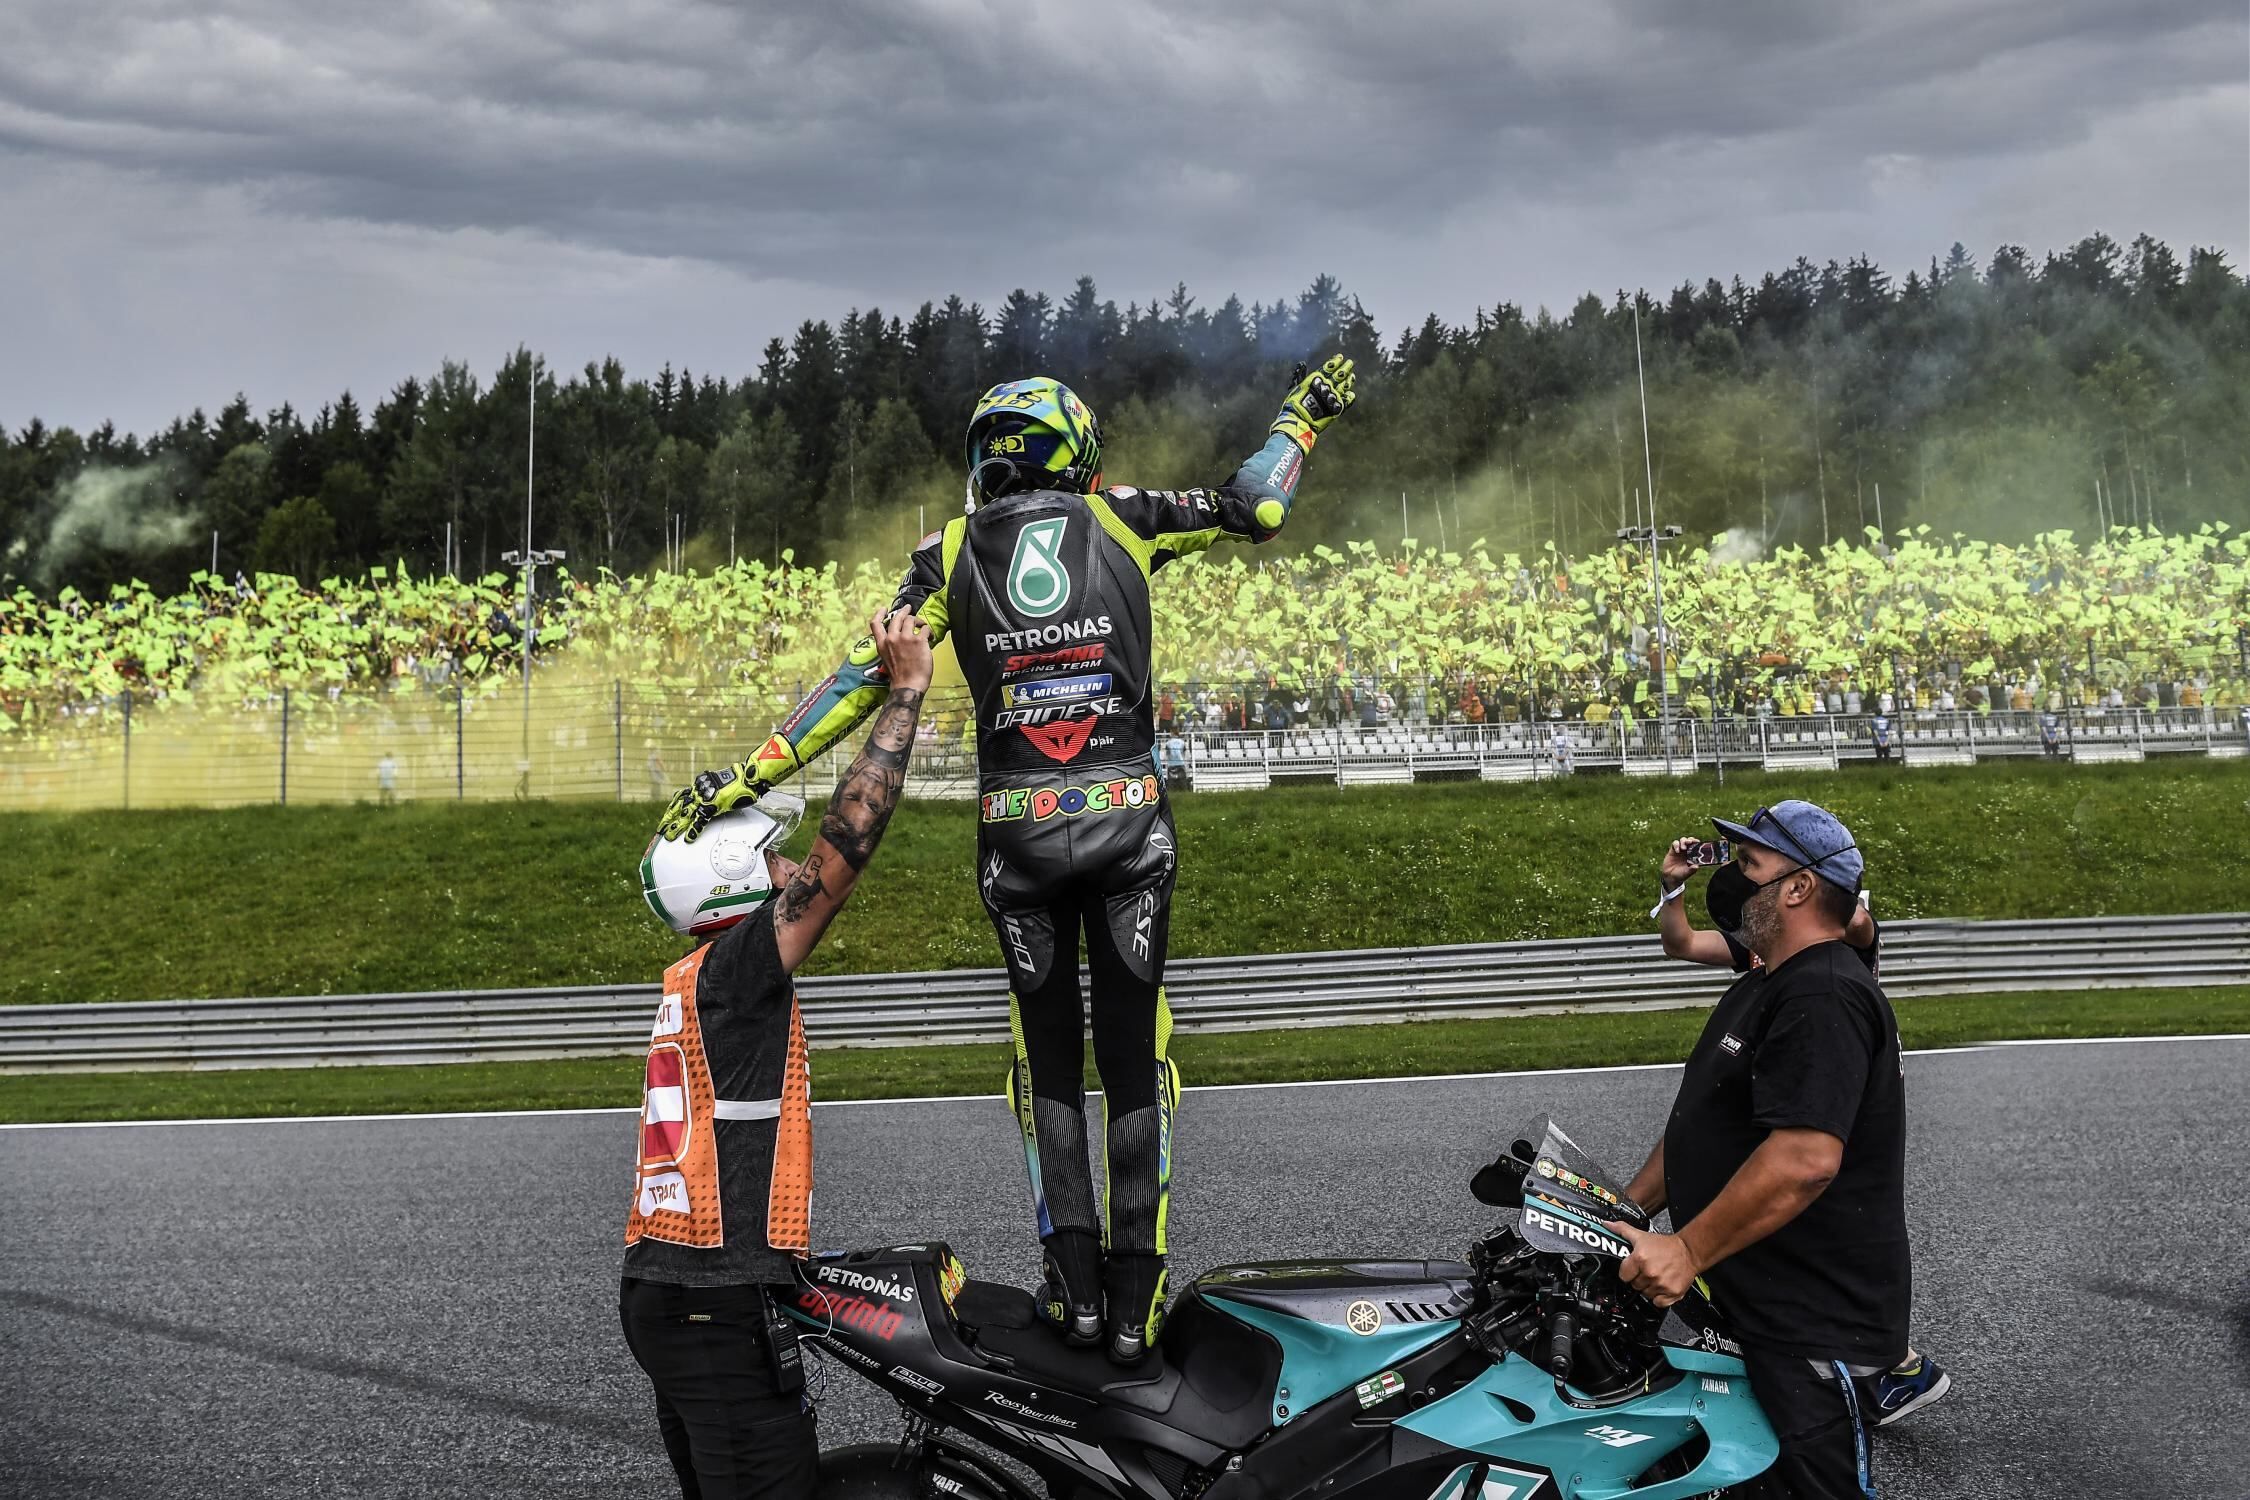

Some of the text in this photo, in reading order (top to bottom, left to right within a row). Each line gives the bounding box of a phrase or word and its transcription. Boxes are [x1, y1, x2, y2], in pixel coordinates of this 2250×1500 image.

[1266, 441, 1299, 488] PETRONAS
[985, 616, 1113, 653] PETRONAS
[1061, 659, 1102, 671] TEAM
[785, 676, 837, 732] BARRACUDA
[1033, 682, 1103, 698] MICHELIN
[982, 775, 1160, 823] THE DOCTOR
[710, 884, 731, 895] 46
[1525, 1208, 1631, 1259] PETRONA
[817, 1266, 915, 1302] PETRONAS
[1701, 1378, 1730, 1395] YAMAHA
[984, 1390, 1078, 1429] Revs Your Heart
